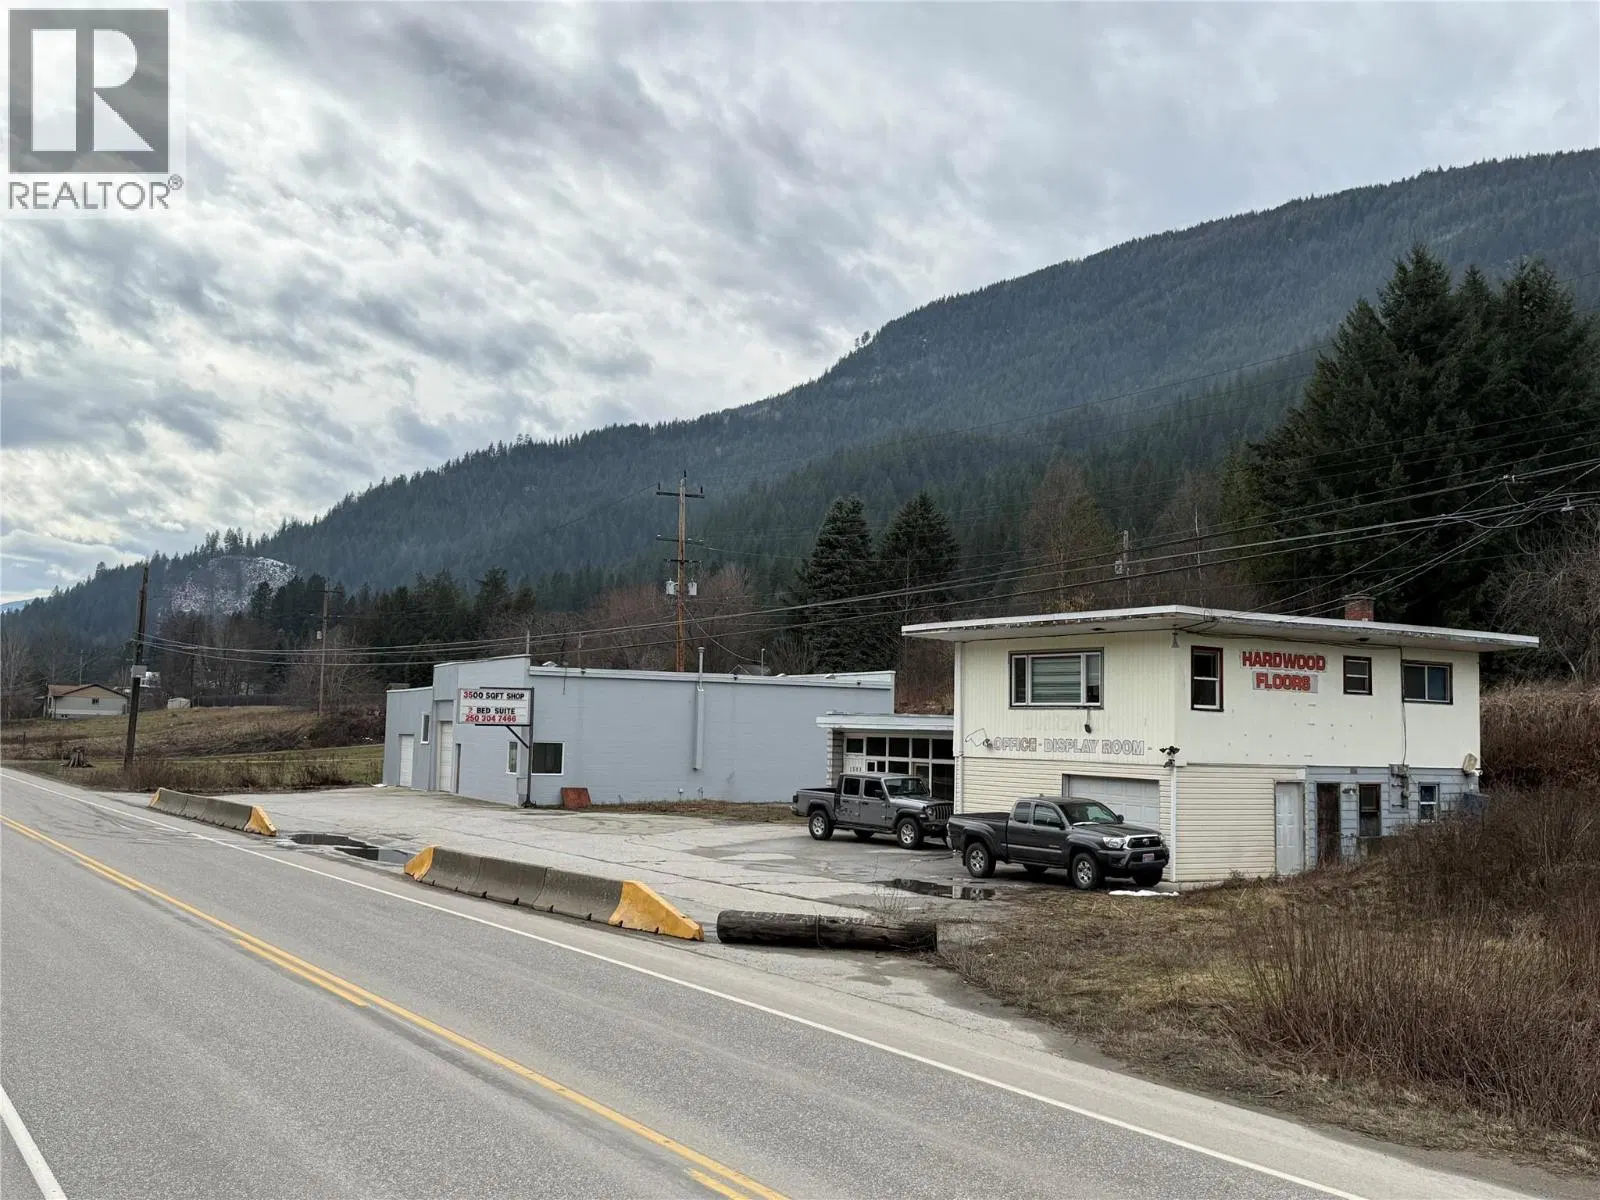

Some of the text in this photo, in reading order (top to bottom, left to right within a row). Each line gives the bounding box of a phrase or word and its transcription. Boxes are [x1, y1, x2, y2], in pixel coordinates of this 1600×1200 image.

[1242, 651, 1326, 671] HARDWOOD
[1256, 673, 1310, 691] FLOORS
[463, 691, 484, 699] 3500
[494, 707, 516, 715] SUITE
[993, 736, 1037, 752] OFFICE
[1043, 738, 1099, 754] DISPLAY
[1101, 739, 1145, 756] ROOM
